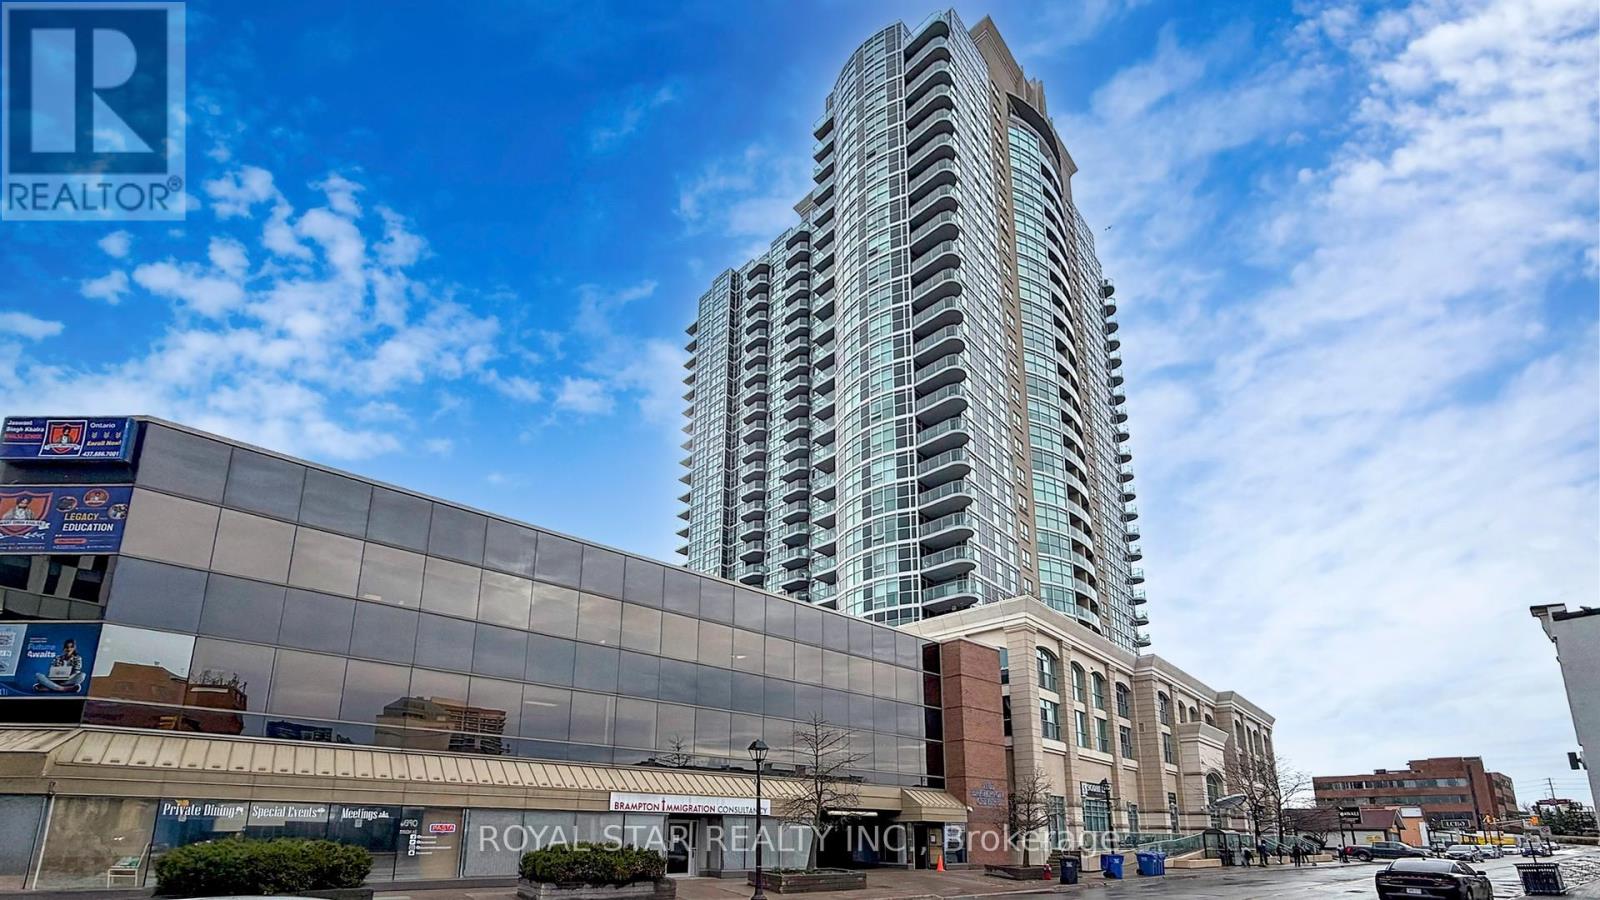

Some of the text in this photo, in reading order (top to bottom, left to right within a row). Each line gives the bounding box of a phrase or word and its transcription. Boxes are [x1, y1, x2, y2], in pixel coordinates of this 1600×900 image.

[62, 523, 114, 531] EDUCATION
[163, 803, 235, 818] Private Dining
[252, 805, 317, 818] Special Events
[614, 801, 660, 811] BRAMPTON
[662, 799, 715, 812] IMMIGRATION
[342, 808, 378, 820] Meetings
